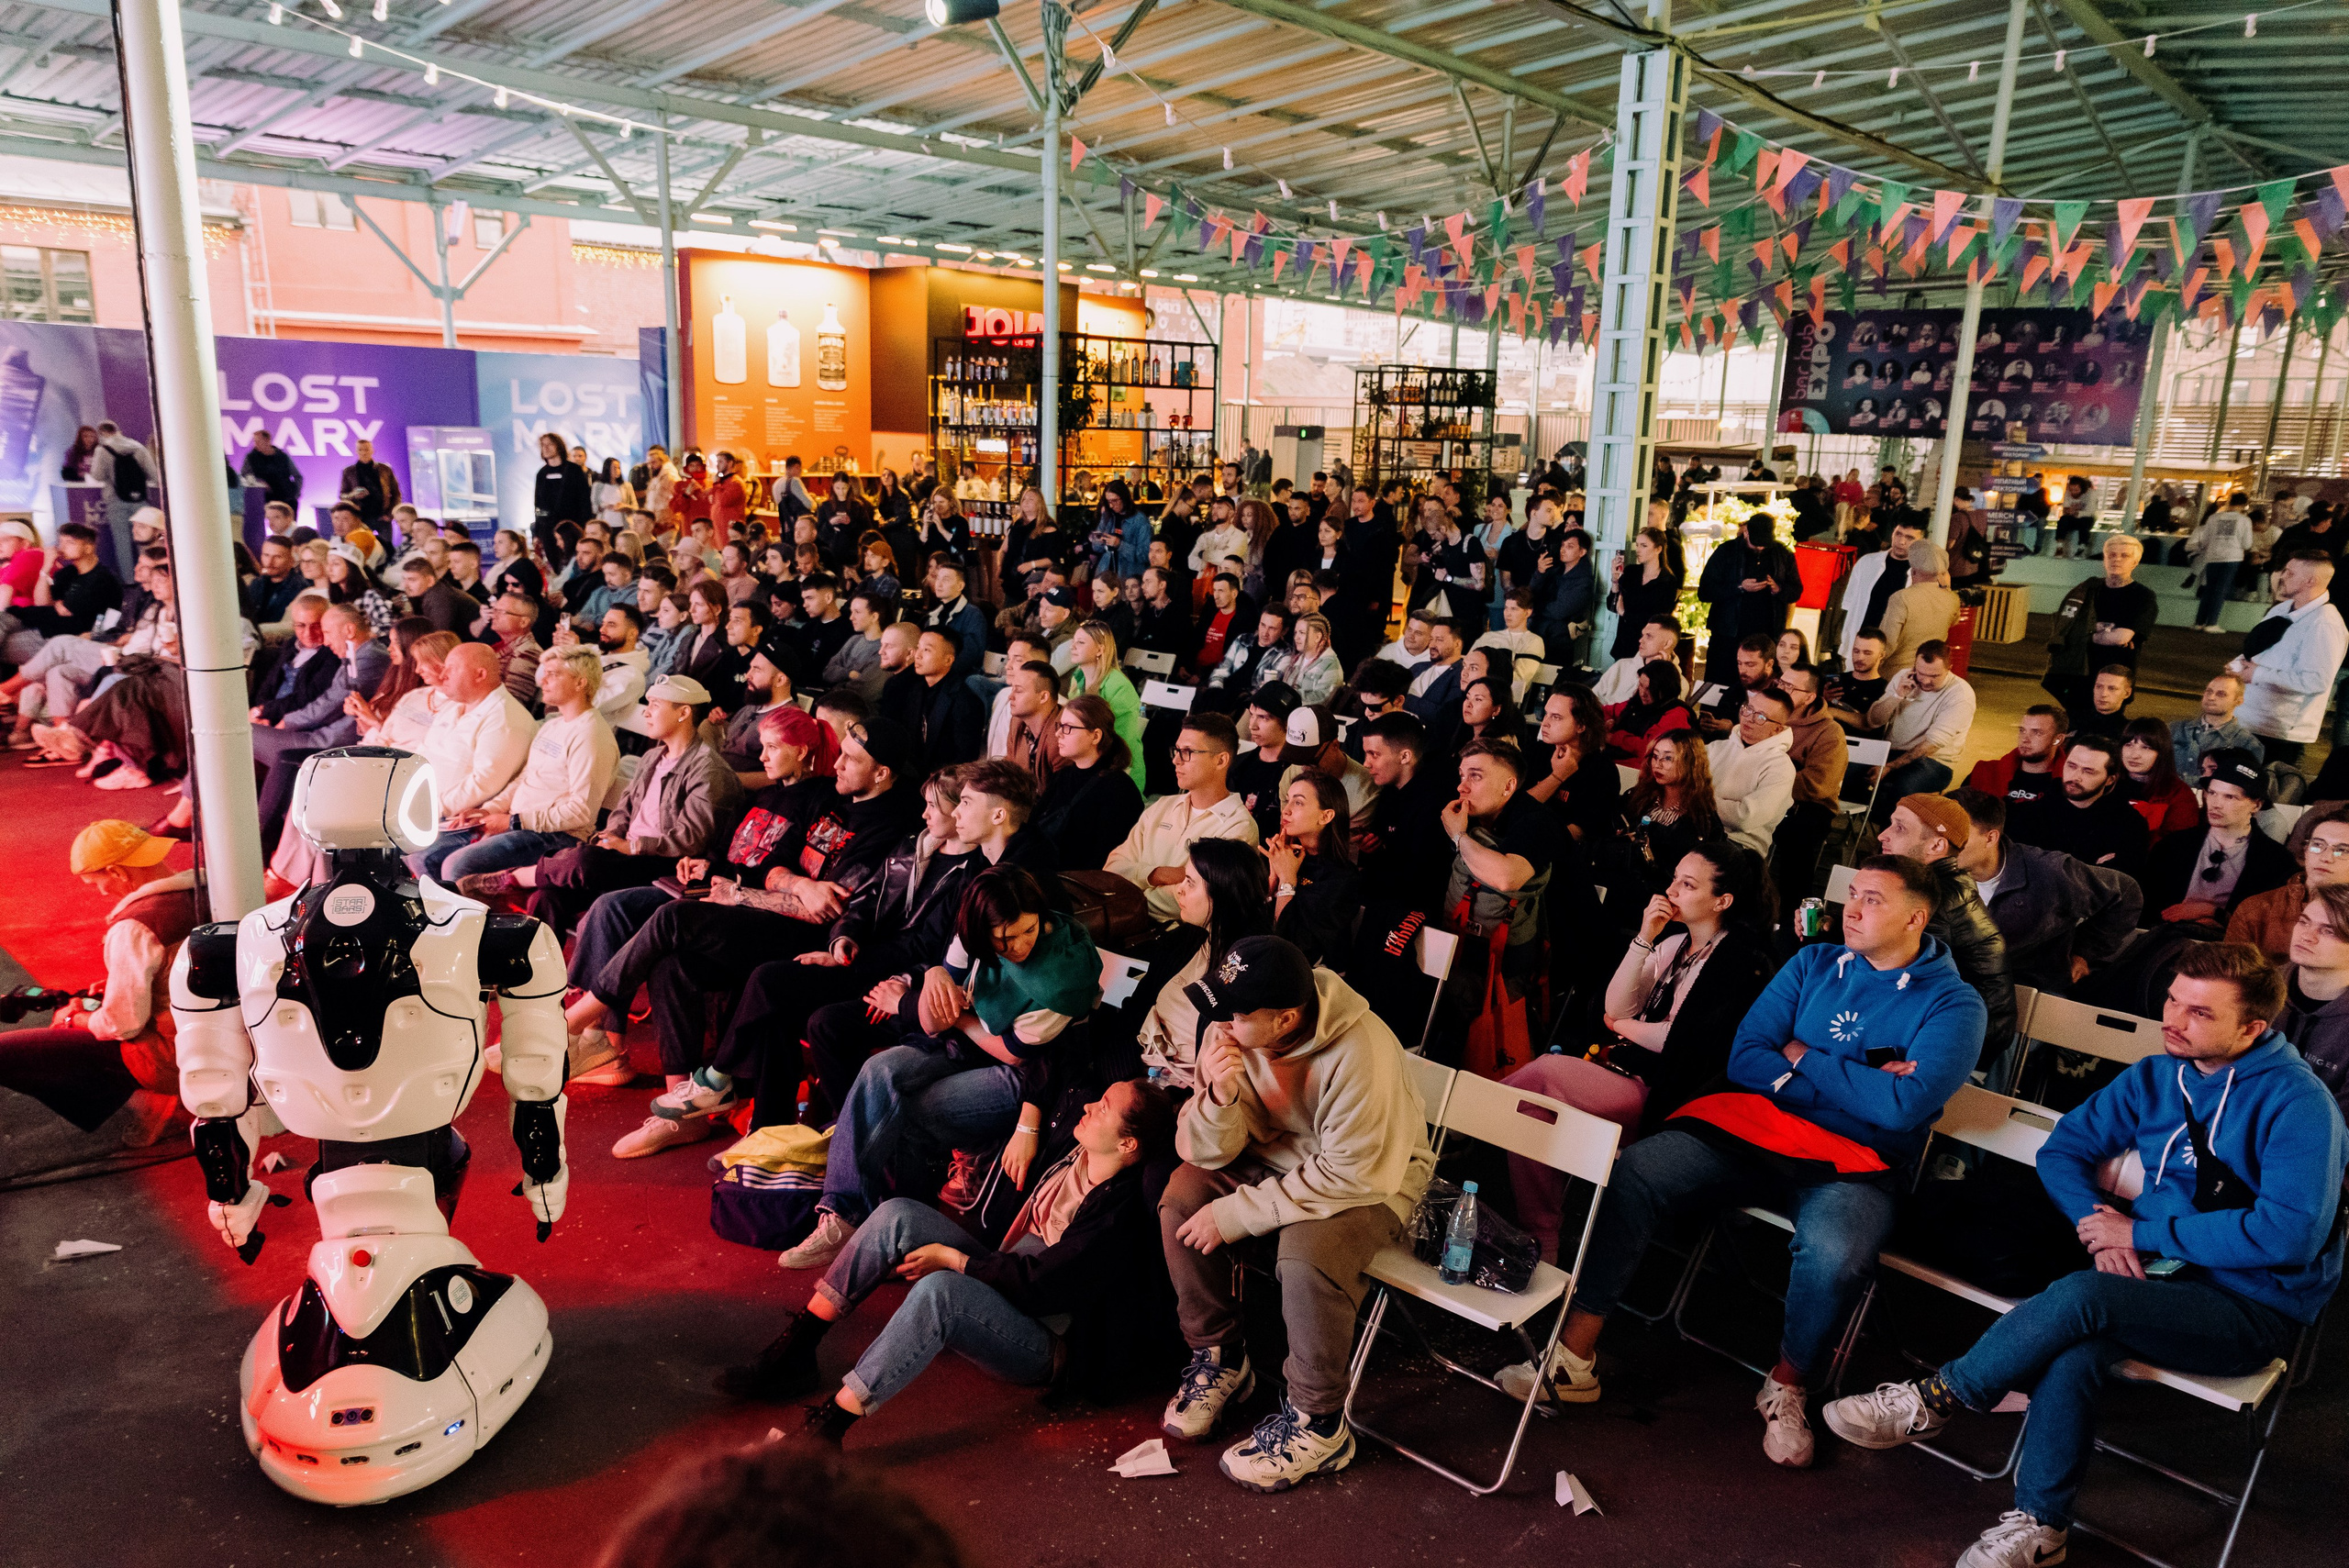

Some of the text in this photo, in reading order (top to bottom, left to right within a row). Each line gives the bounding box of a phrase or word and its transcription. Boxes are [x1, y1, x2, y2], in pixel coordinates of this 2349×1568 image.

[1788, 323, 1816, 399] bar hub
[1807, 320, 1836, 400] EXPO
[217, 370, 380, 414] LOST
[510, 378, 640, 418] LOST
[221, 415, 384, 457] MARY
[1987, 511, 2015, 519] MERCH
[2008, 789, 2037, 800] eBar
[1271, 1200, 1282, 1226] ESSENTIAL
